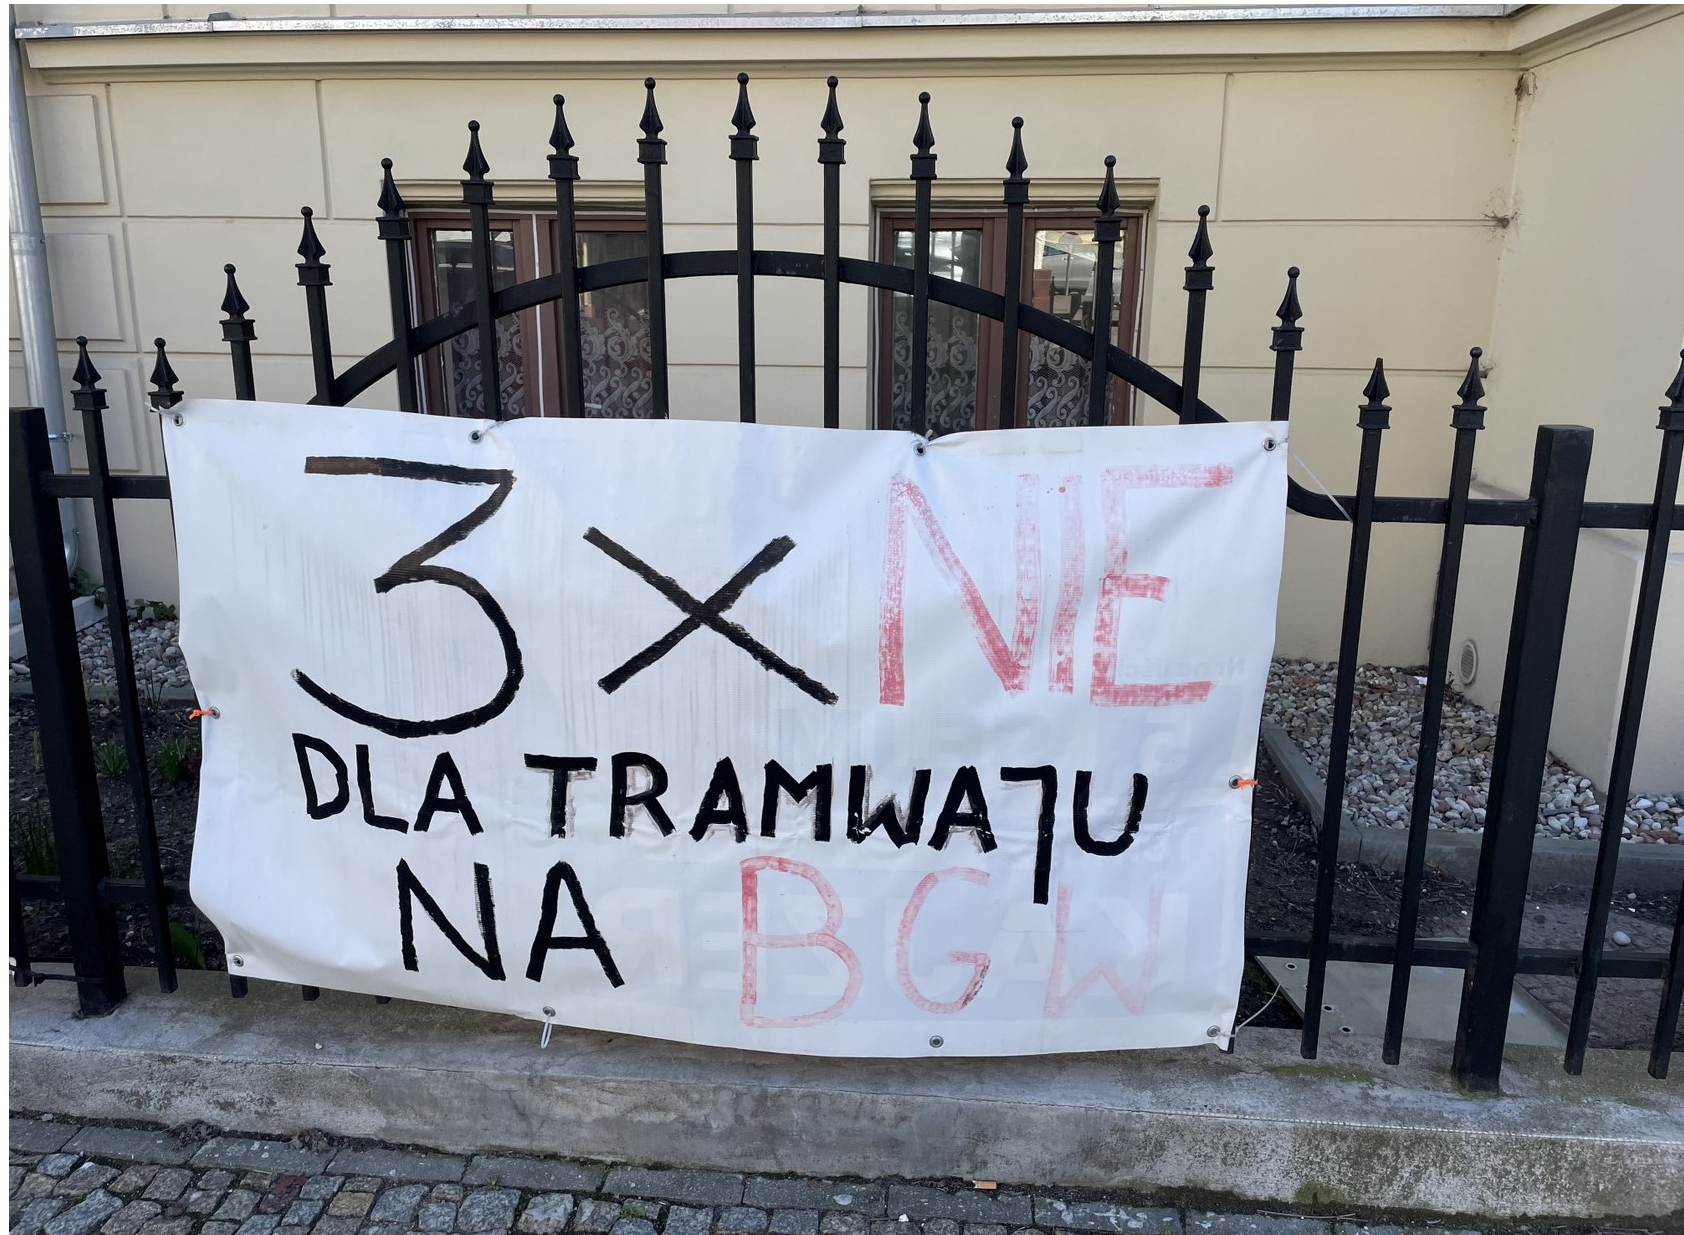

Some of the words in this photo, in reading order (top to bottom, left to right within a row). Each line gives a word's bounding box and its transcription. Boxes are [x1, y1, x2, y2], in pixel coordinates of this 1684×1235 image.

[290, 455, 524, 739] 3
[877, 463, 1234, 707] NIE
[290, 731, 485, 835] DLA
[396, 857, 625, 988] NA
[739, 855, 1163, 1029] BGW
